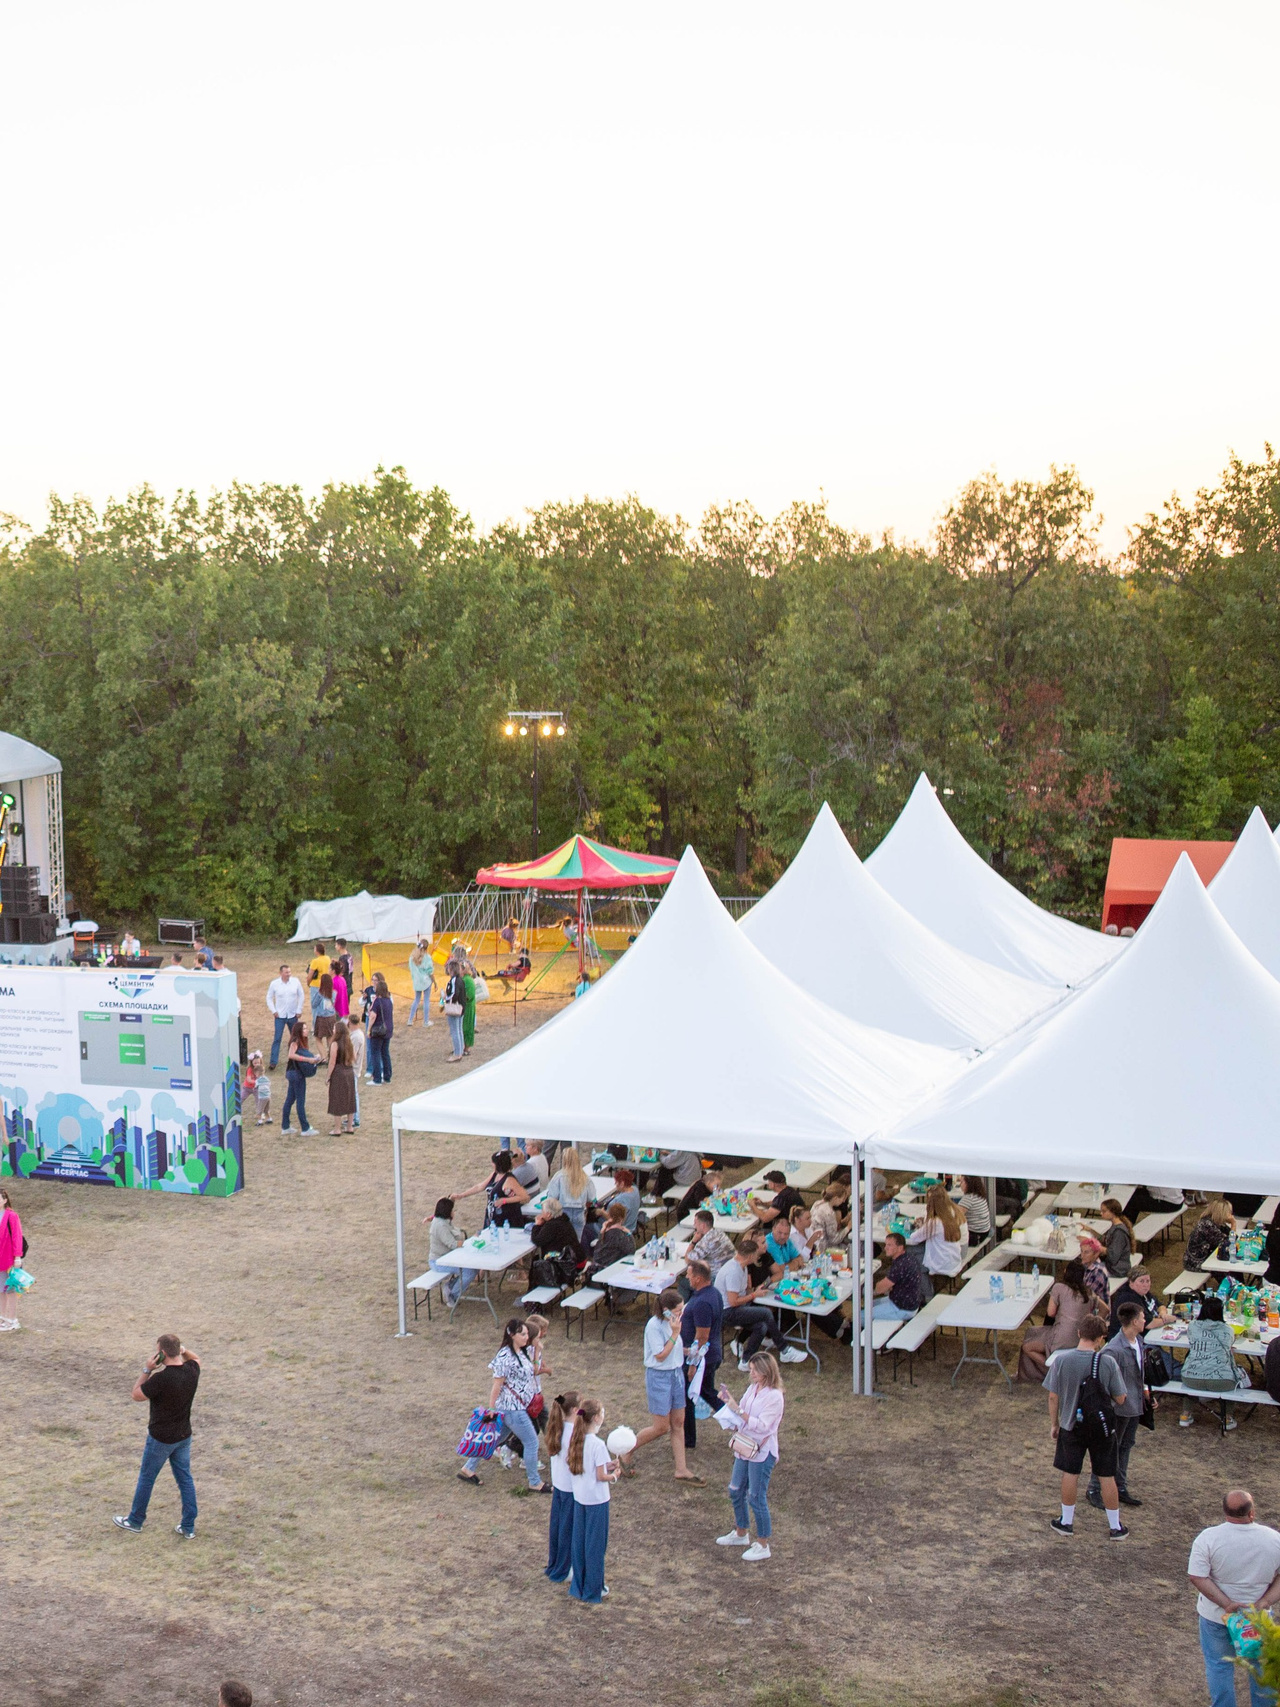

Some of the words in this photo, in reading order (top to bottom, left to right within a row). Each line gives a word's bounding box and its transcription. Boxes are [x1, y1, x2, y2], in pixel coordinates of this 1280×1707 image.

[99, 1001, 124, 1009] СХЕМА
[124, 1002, 169, 1011] ПЛОЩАДКИ
[60, 1168, 89, 1177] СЕЙЧАС
